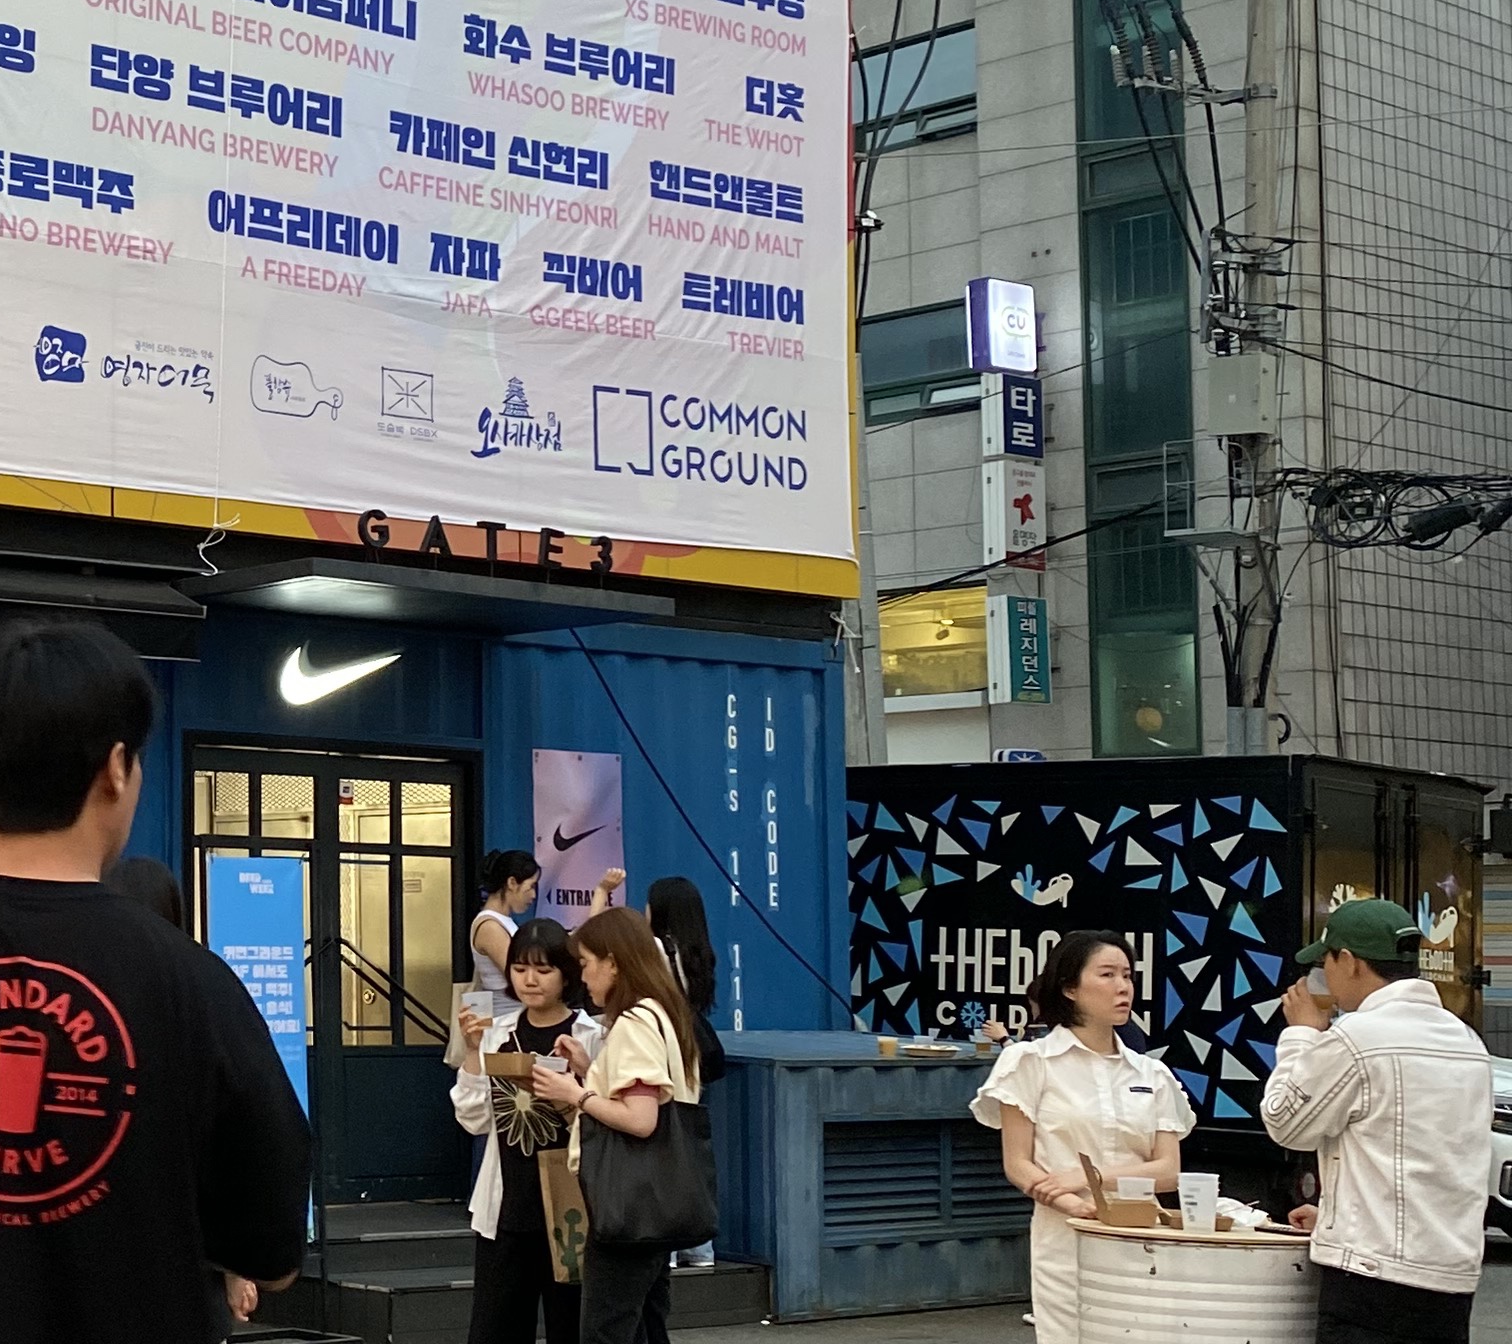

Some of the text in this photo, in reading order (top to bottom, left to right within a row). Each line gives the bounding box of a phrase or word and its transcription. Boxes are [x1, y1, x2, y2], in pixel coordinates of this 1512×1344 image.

[211, 11, 273, 47] BEER
[279, 27, 394, 76] COMPANY
[463, 13, 676, 96] 화수 브루어리
[654, 3, 746, 44] BREWING
[751, 24, 806, 57] ROOM
[90, 43, 343, 139] 단양 브루어리
[467, 70, 670, 131] WHASOO BREWERY
[92, 106, 339, 179] DANYANG BREWERY
[389, 110, 609, 191] 카페인 신현리
[705, 118, 805, 158] THE WHOT
[379, 165, 619, 231] CAFFEINE SINHYEONRI
[650, 160, 805, 224] 핸드앤몰트
[47, 221, 173, 265] BREWERY
[208, 188, 399, 265] 어프리데이
[648, 213, 805, 260] HAND AND MALT
[241, 256, 367, 298] A FREEDAY
[430, 232, 502, 282] 자파
[441, 292, 494, 319] JAFA
[530, 304, 657, 342] GGEEK BEER
[682, 272, 805, 326] 트레비어
[727, 331, 805, 362] TREVIER
[660, 393, 807, 443] COMMON
[1010, 385, 1037, 447] 타로
[660, 444, 808, 492] GROUND
[358, 508, 565, 571] GATE
[766, 789, 779, 907] CODE
[557, 888, 614, 907] ENTRAE
